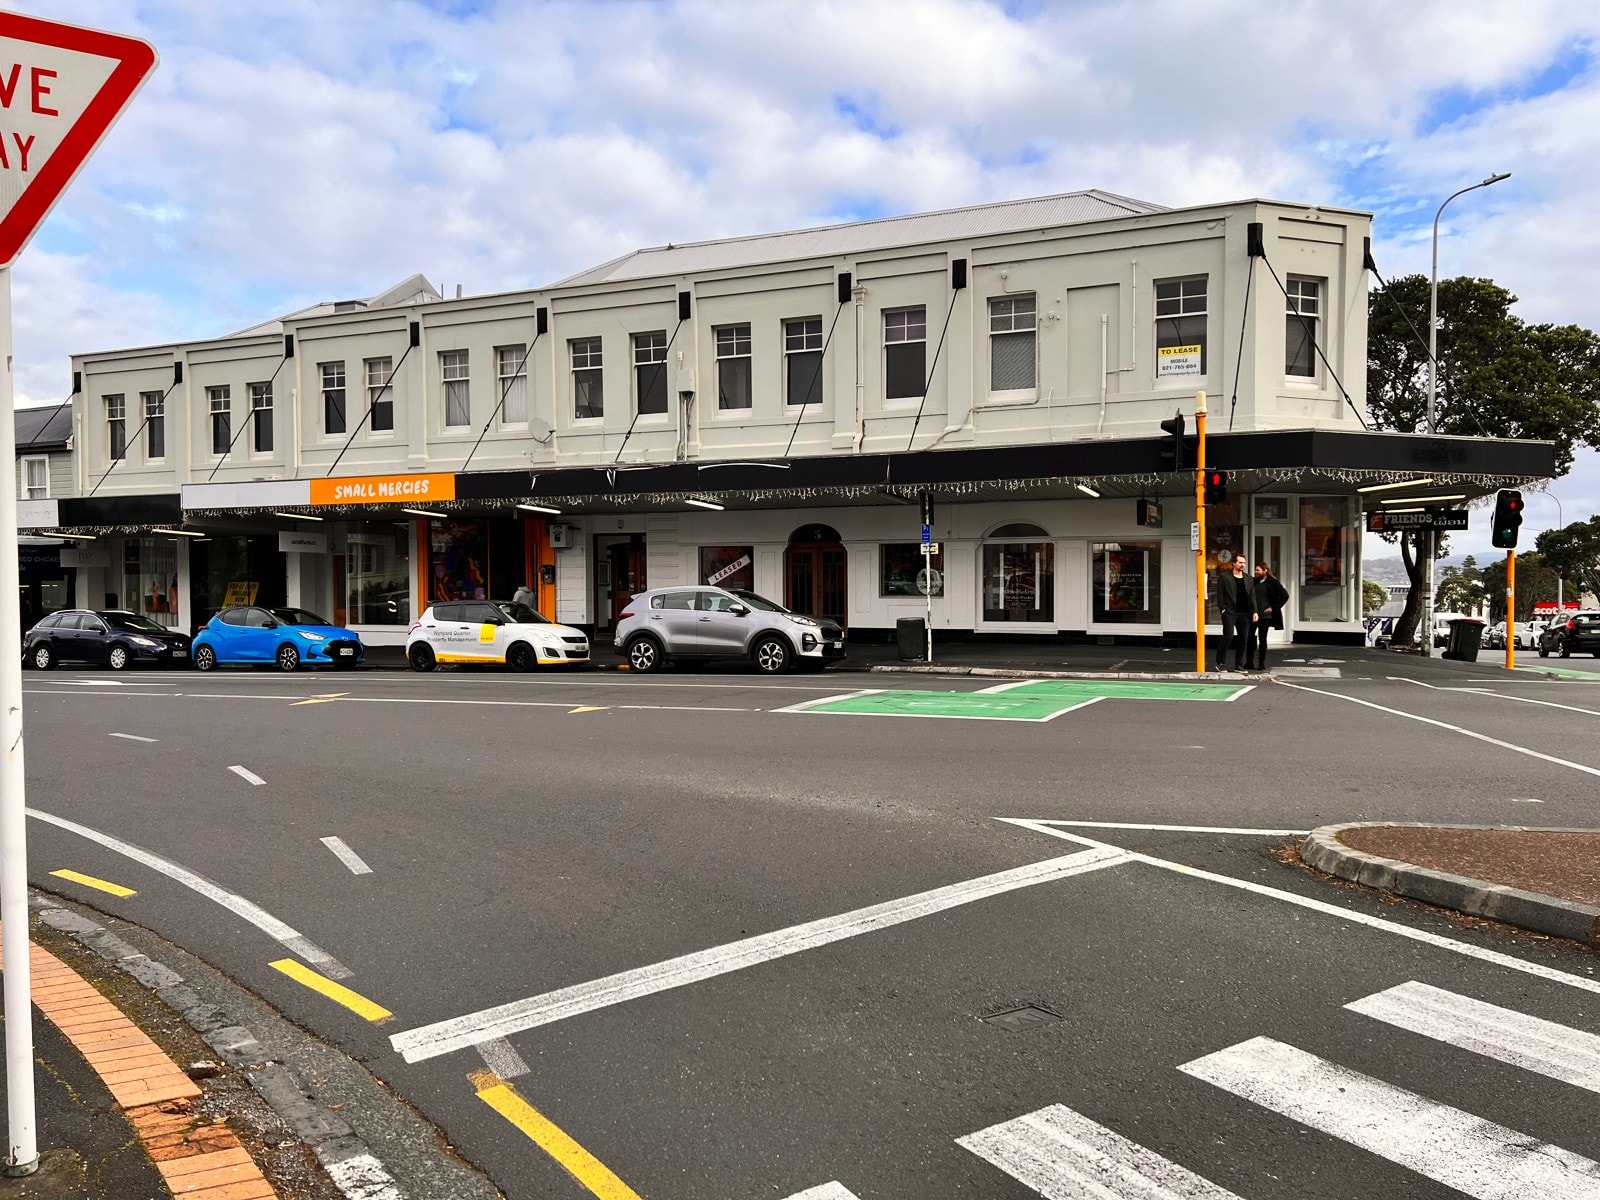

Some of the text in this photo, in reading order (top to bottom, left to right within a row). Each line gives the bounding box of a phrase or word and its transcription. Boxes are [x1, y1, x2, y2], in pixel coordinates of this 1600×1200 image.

[334, 480, 429, 499] SMALL MERCIES
[1384, 514, 1433, 524] FRIENDS
[714, 560, 742, 581] LEASED
